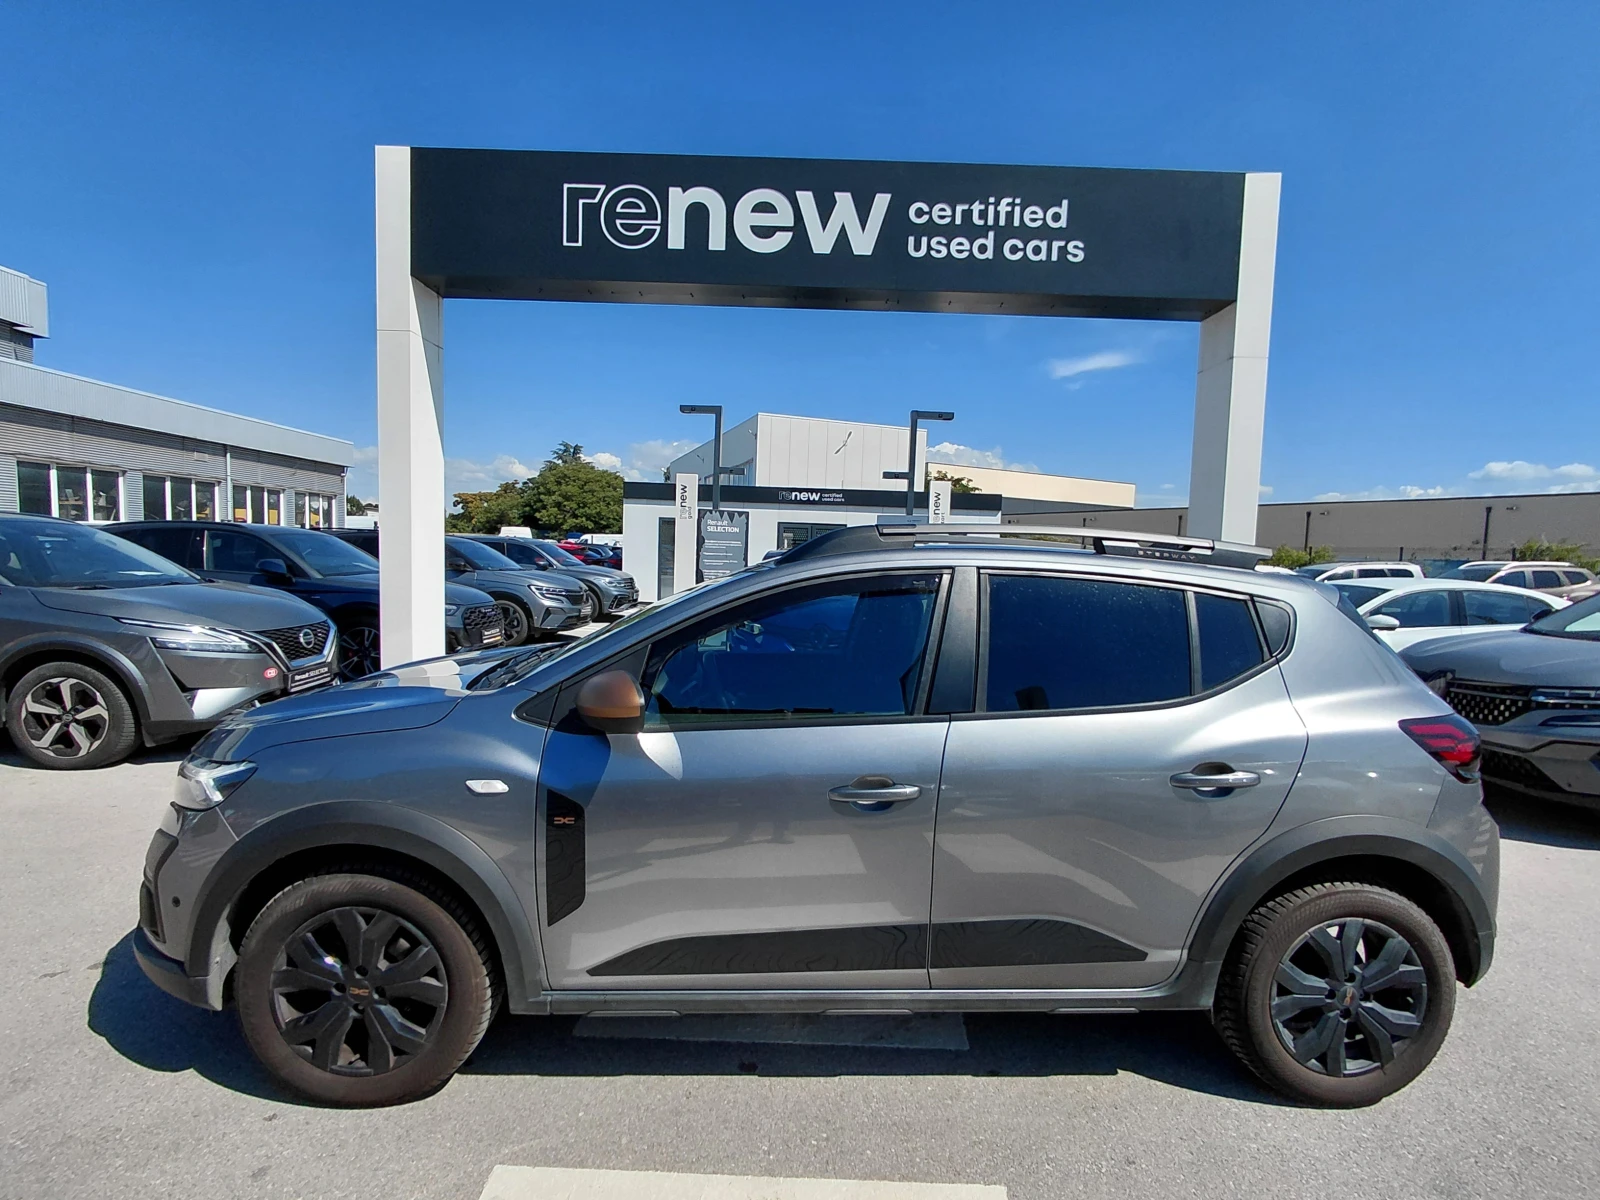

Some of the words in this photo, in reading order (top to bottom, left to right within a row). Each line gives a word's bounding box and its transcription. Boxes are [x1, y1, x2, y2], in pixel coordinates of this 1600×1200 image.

[562, 183, 892, 255] renew
[908, 196, 1069, 229] certified
[907, 231, 995, 260] used
[1002, 238, 1085, 263] cars
[779, 491, 820, 500] renew
[1138, 551, 1195, 559] STEPWAY
